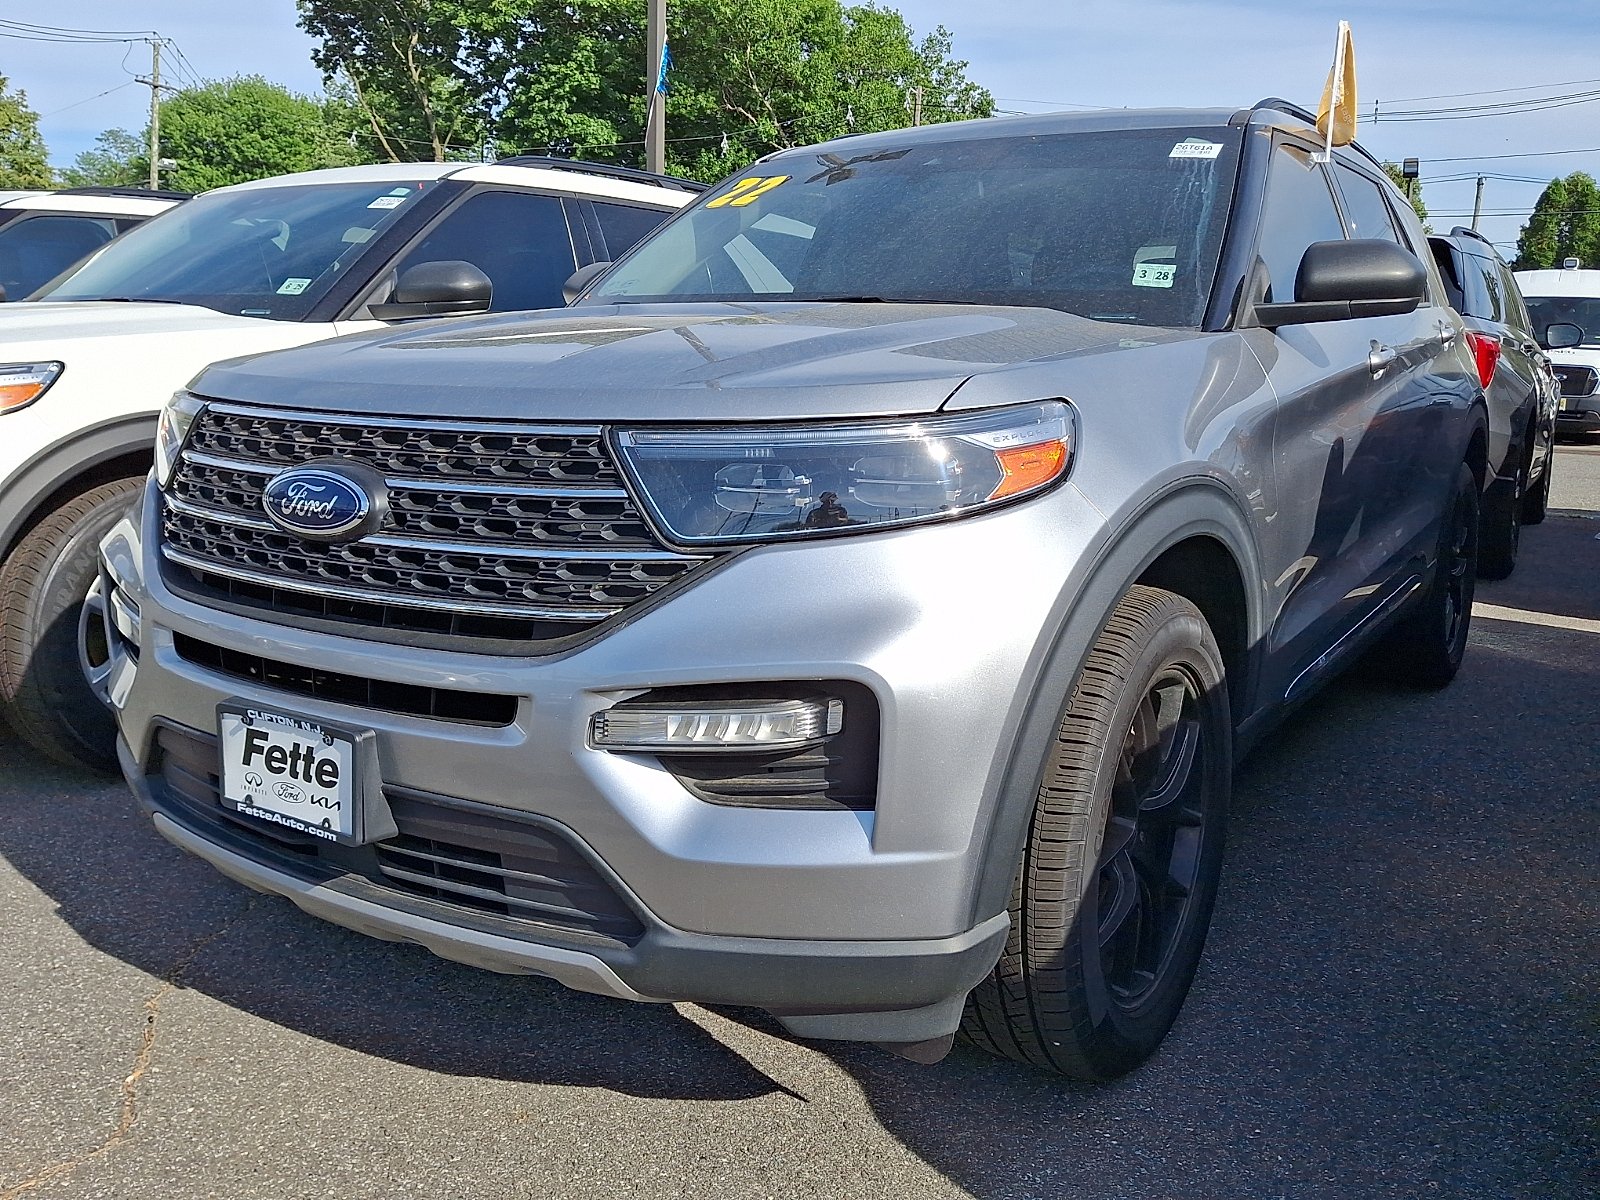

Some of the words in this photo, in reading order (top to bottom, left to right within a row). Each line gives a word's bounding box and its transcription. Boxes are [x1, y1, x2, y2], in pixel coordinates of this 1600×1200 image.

[704, 174, 792, 209] 22
[1139, 269, 1147, 279] 3
[1155, 271, 1170, 281] 28
[281, 481, 339, 520] Ford
[247, 709, 299, 729] CLIFTON,
[241, 727, 340, 789] Fette
[277, 783, 301, 802] Ford
[236, 802, 337, 842] FetteAuto.com
